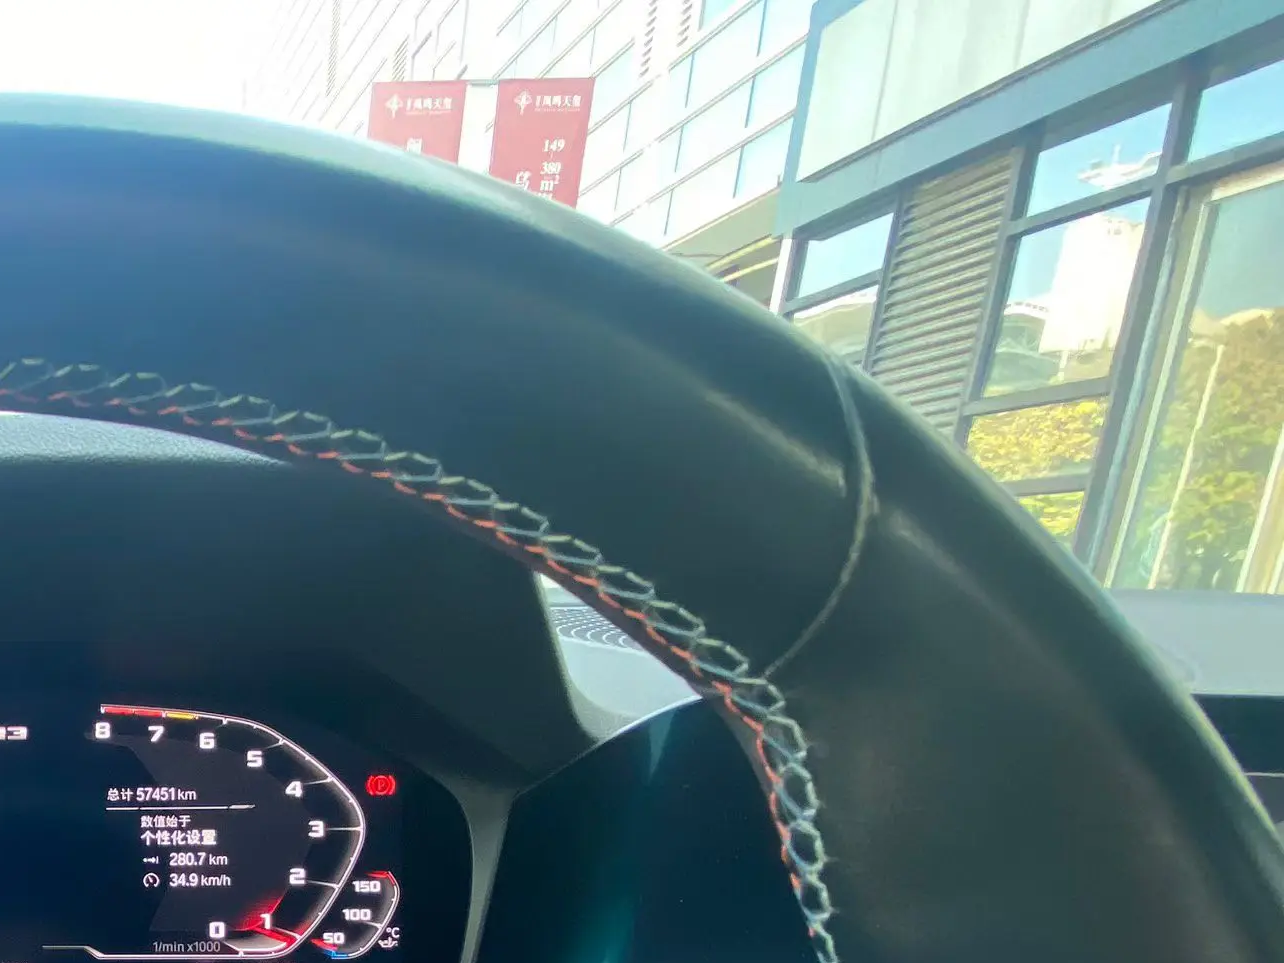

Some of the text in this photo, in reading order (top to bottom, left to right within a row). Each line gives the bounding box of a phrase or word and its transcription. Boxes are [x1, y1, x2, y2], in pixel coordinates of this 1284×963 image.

[543, 139, 566, 152] 149
[94, 722, 110, 740] 8
[148, 725, 165, 743] 7
[199, 732, 216, 750] 6
[246, 751, 263, 767] 5
[107, 787, 197, 801] 总计 57451 km
[285, 781, 303, 798] 4
[140, 815, 191, 828] 数值始于
[308, 821, 325, 838] 3
[141, 829, 217, 845] 个性化设置
[169, 852, 228, 866] 280.7 km
[169, 873, 231, 887] 34.9 km/h
[289, 868, 306, 884] 2
[352, 881, 381, 893] 150
[260, 913, 272, 930] 1
[342, 909, 371, 921] 100
[209, 921, 225, 938] 0
[323, 932, 344, 944] 50
[152, 941, 220, 953] 1/min x1000
